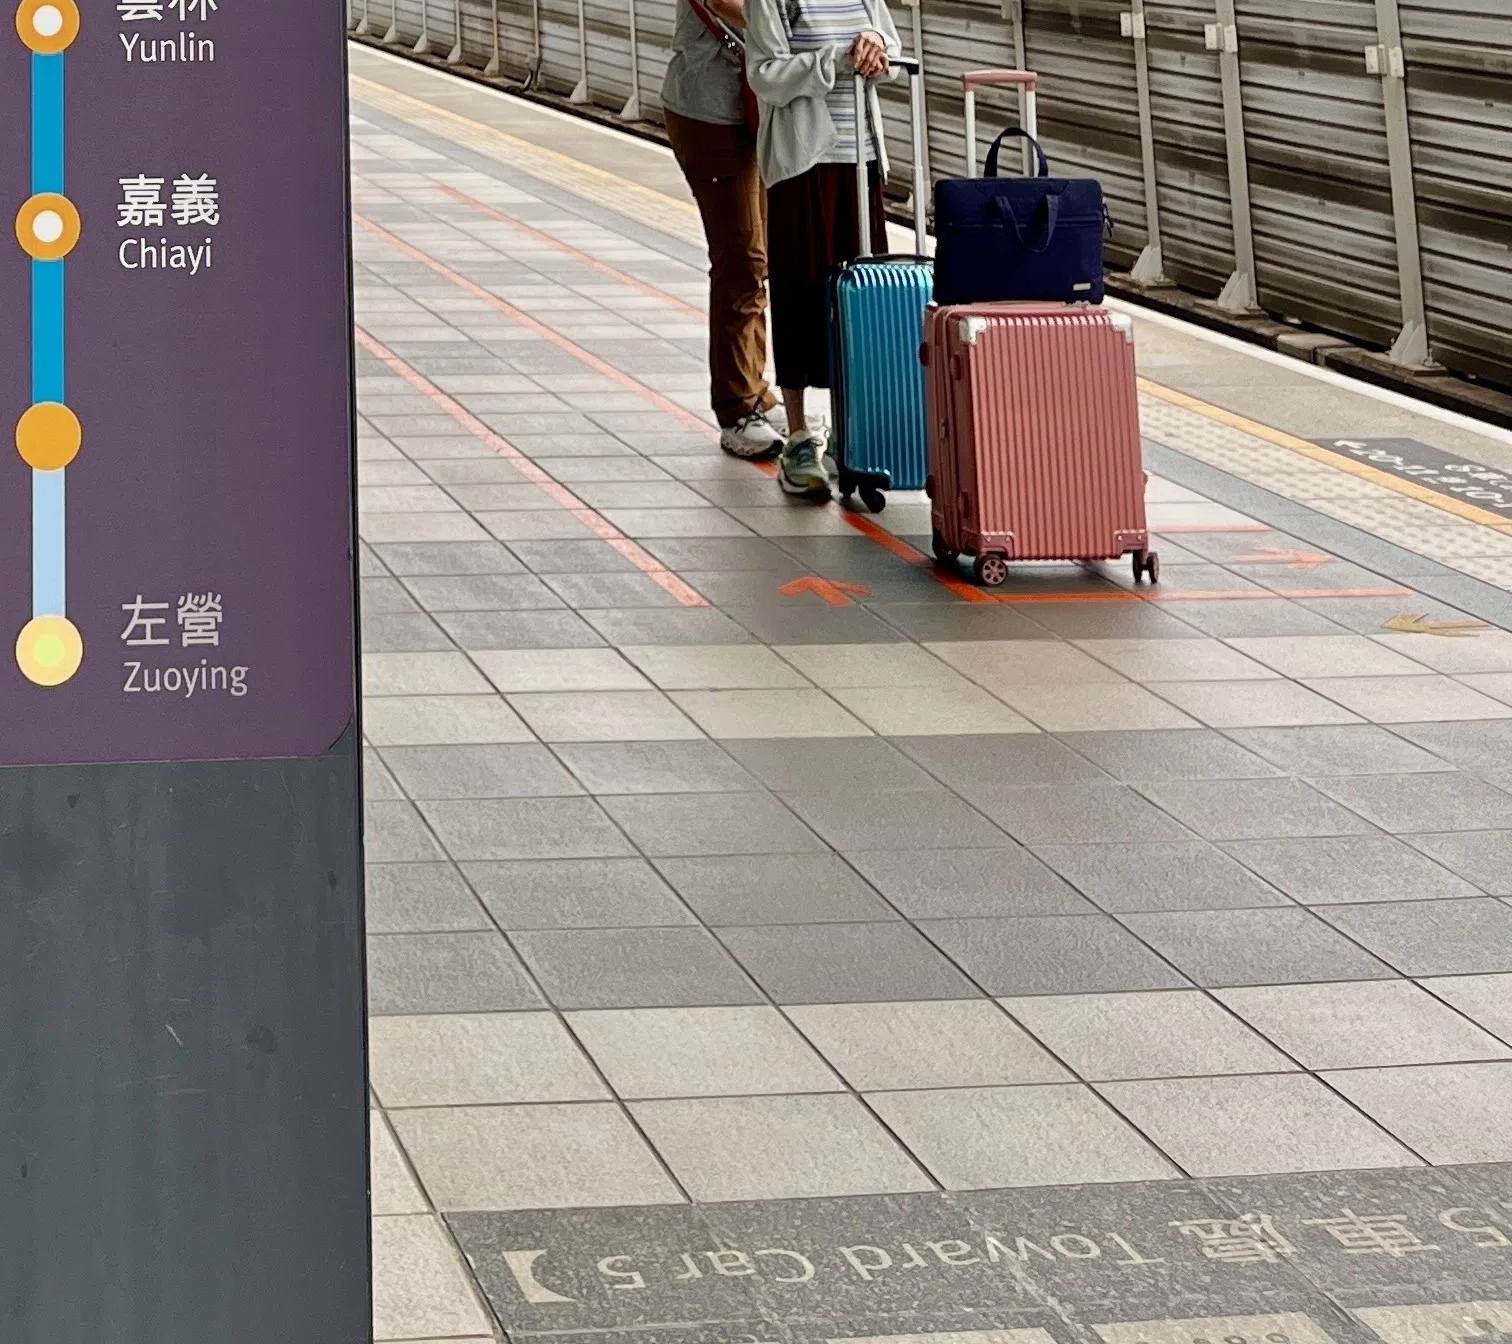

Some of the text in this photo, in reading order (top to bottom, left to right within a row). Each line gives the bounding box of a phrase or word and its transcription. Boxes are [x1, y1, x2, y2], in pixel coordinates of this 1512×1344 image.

[119, 31, 215, 63] Yunlin
[116, 172, 221, 228] 嘉義
[118, 237, 213, 276] Chiayi
[120, 591, 224, 648] 左營
[122, 658, 250, 698] Zuoying
[595, 1253, 648, 1290] 5
[674, 1247, 817, 1284] Car
[838, 1231, 1166, 1282] Toward
